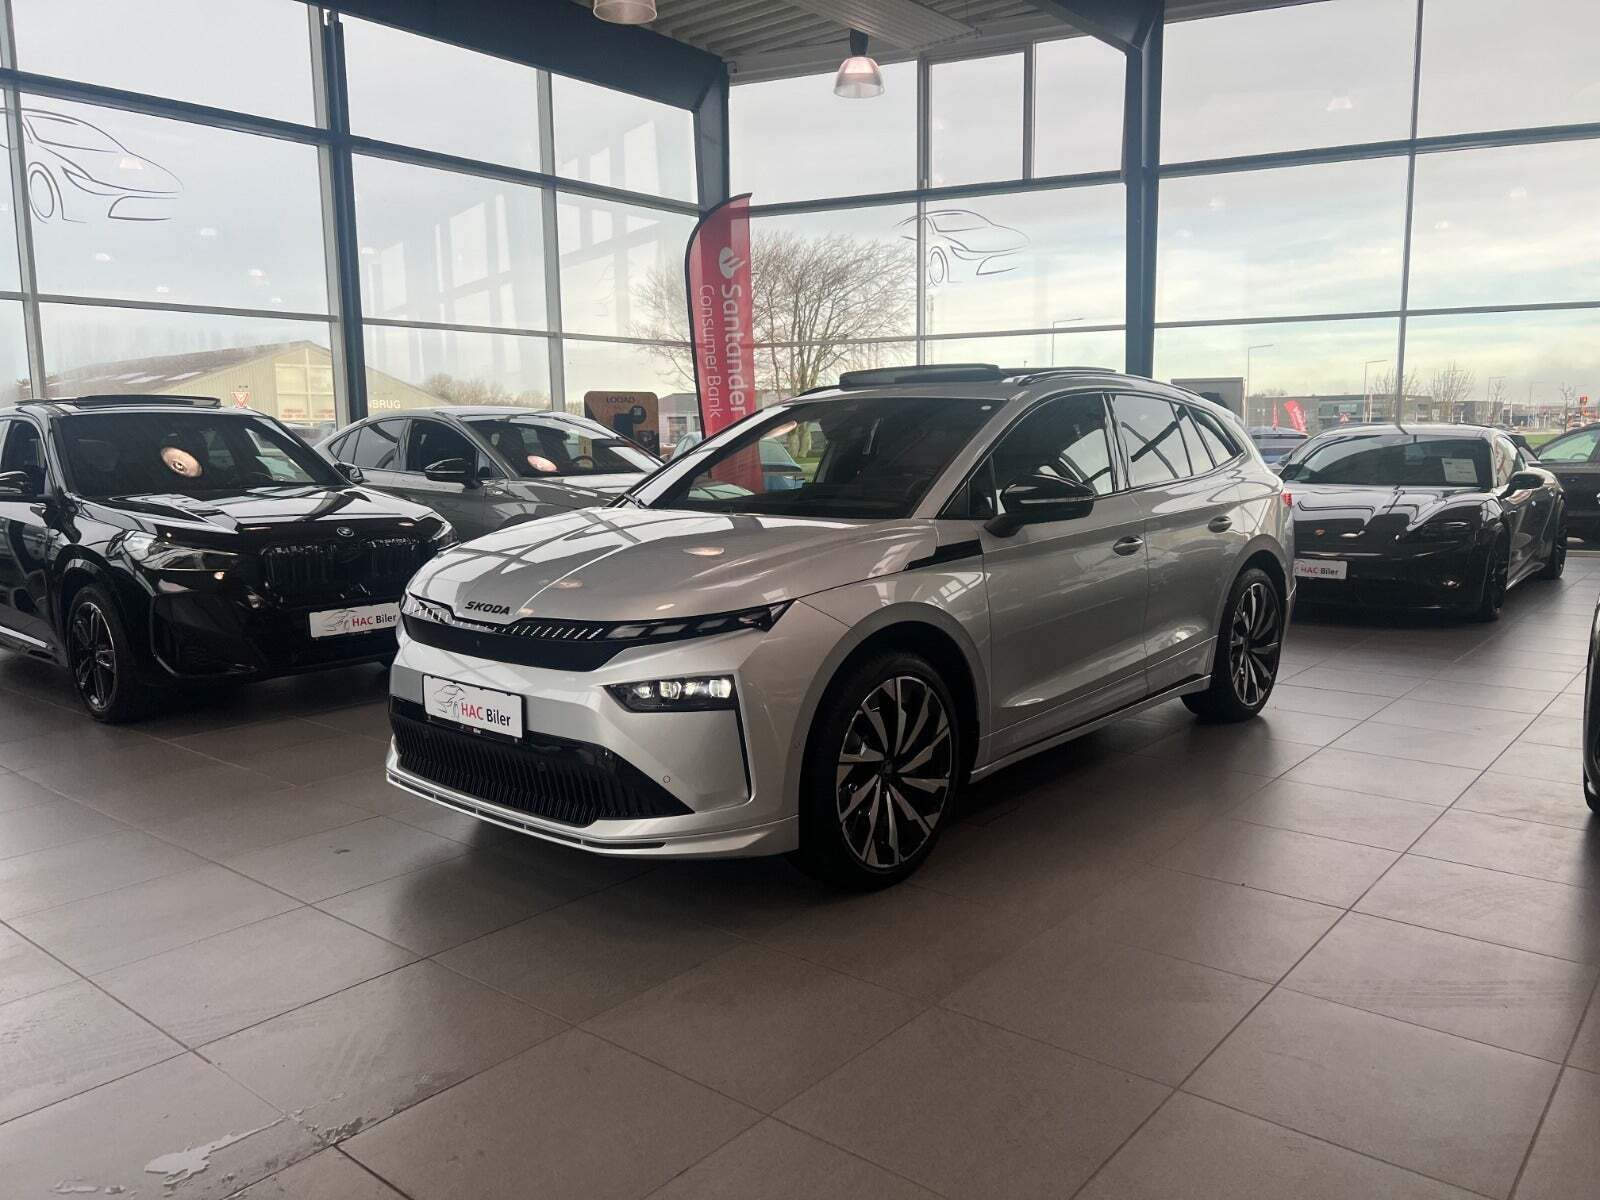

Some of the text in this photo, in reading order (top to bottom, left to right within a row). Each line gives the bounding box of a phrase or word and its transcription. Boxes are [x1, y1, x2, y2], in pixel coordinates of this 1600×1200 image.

[700, 284, 724, 418] Consumer Bank
[721, 284, 746, 415] Santander
[1301, 566, 1339, 576] HAC Biler
[352, 614, 397, 627] HAC Biler
[461, 702, 511, 727] HAC Biler
